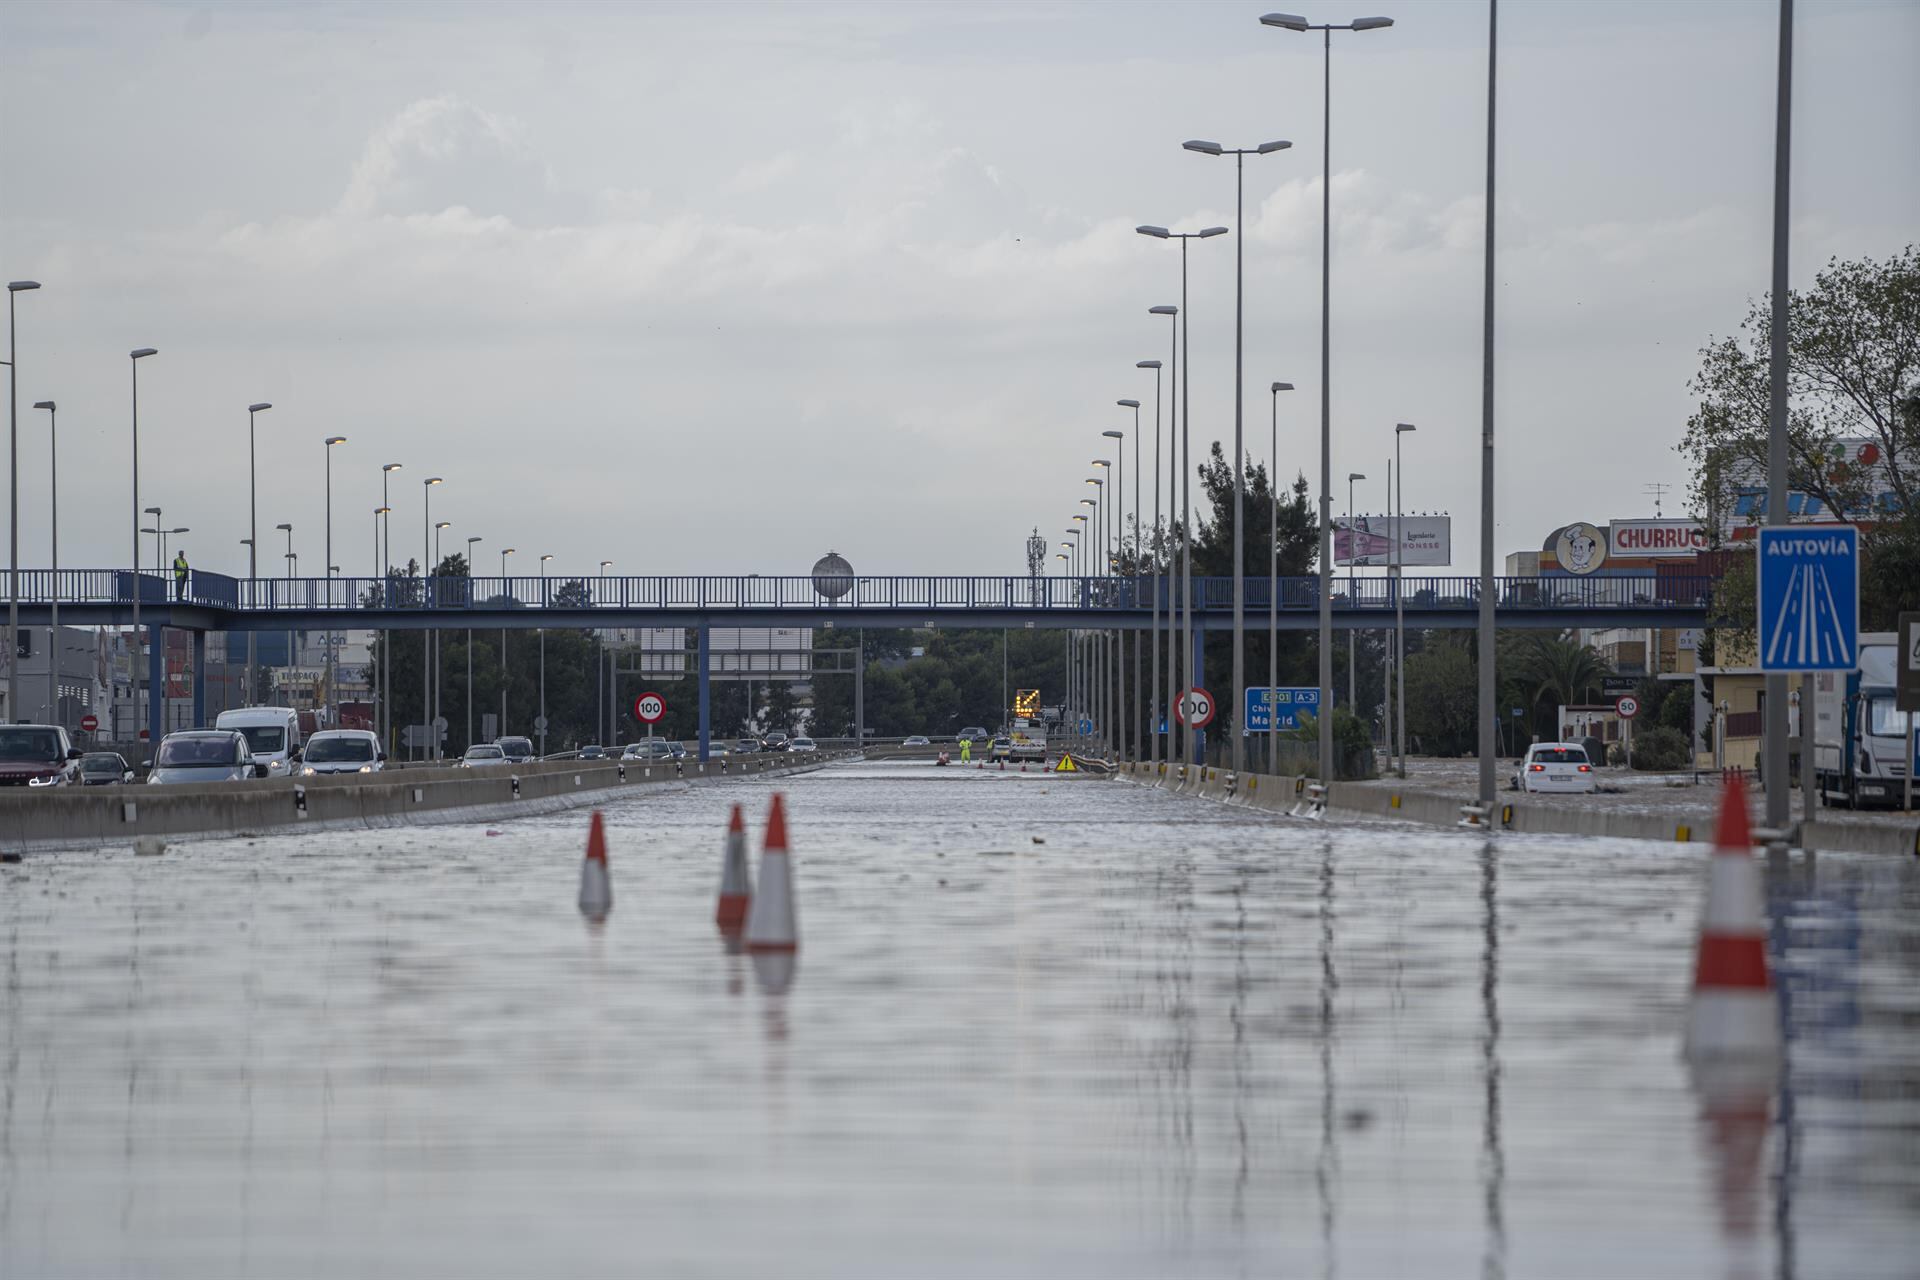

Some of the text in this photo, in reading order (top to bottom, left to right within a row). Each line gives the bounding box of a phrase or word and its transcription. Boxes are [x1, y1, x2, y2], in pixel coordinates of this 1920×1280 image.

[1297, 693, 1316, 702] A-3
[641, 702, 661, 714] 100
[1252, 704, 1274, 713] Chiv
[1621, 702, 1635, 711] 50
